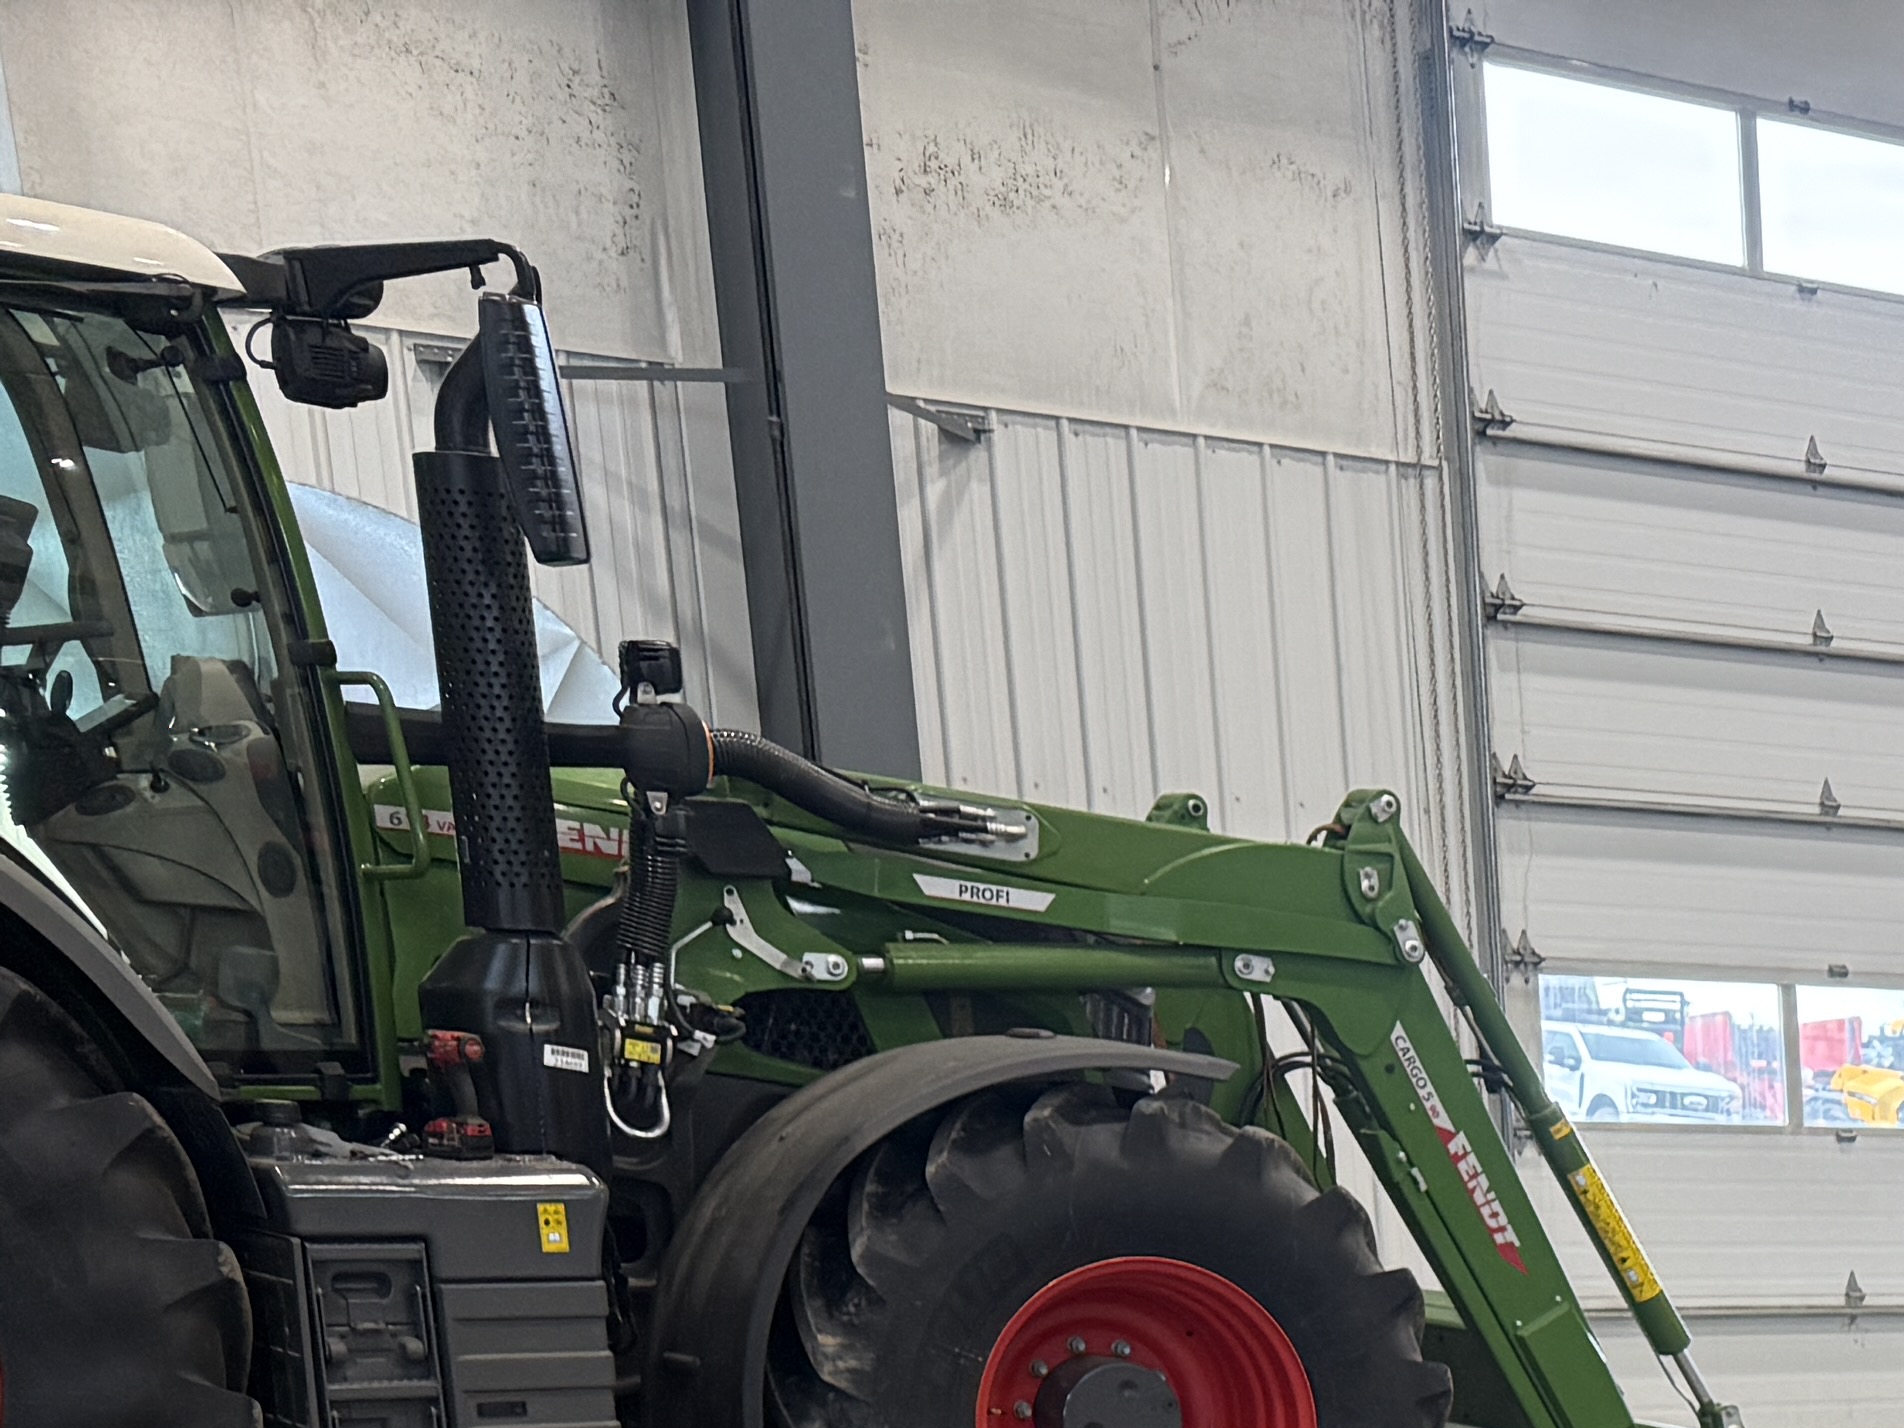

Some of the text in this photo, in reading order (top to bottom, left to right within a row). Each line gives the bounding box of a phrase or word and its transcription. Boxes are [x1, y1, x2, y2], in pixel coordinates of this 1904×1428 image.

[556, 818, 628, 857] EN
[958, 883, 1011, 905] PROFI
[1394, 1035, 1429, 1091] CARGO
[1446, 1130, 1521, 1248] FENDT
